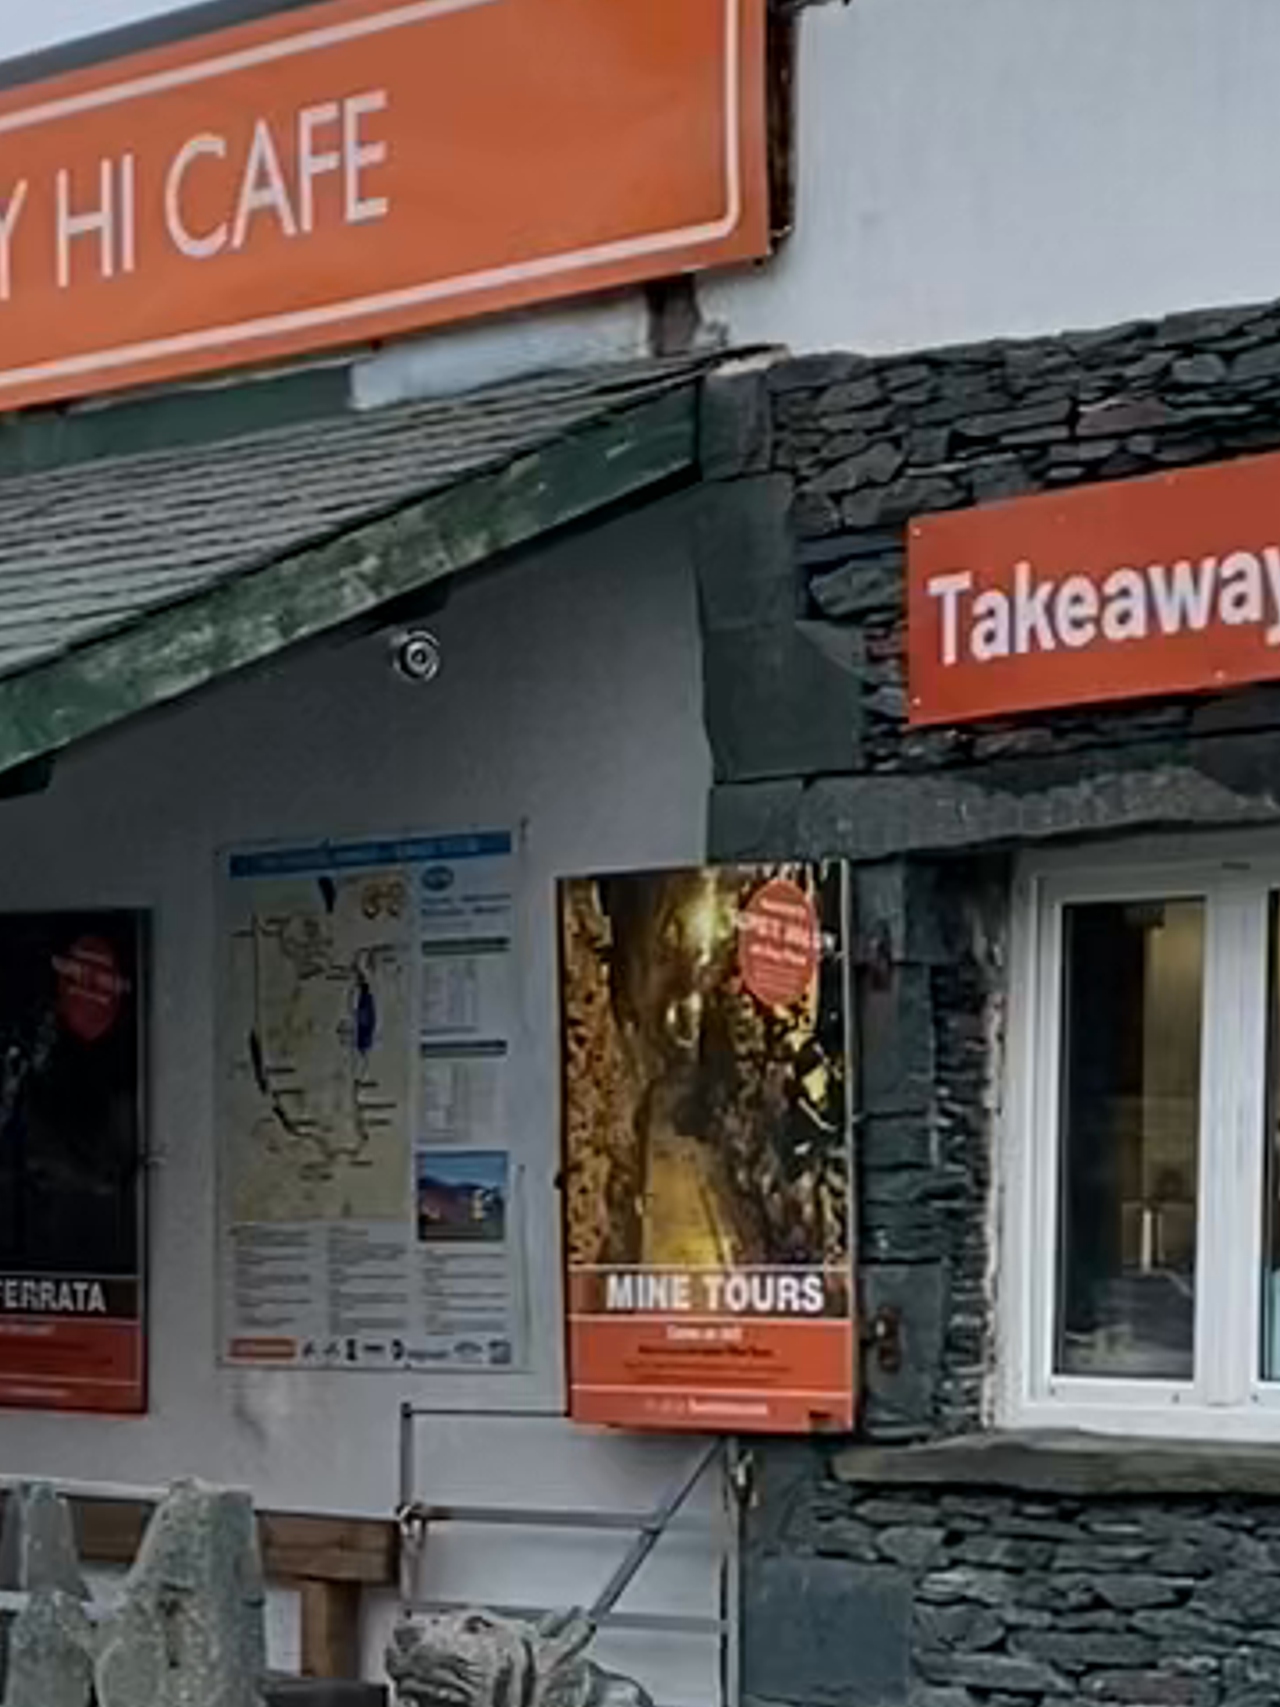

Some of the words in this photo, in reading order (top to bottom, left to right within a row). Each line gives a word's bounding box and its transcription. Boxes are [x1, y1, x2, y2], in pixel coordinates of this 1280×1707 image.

[56, 153, 134, 288] HI
[164, 89, 389, 259] CAFE
[605, 1273, 691, 1311] MINE
[702, 1273, 826, 1313] TOURS
